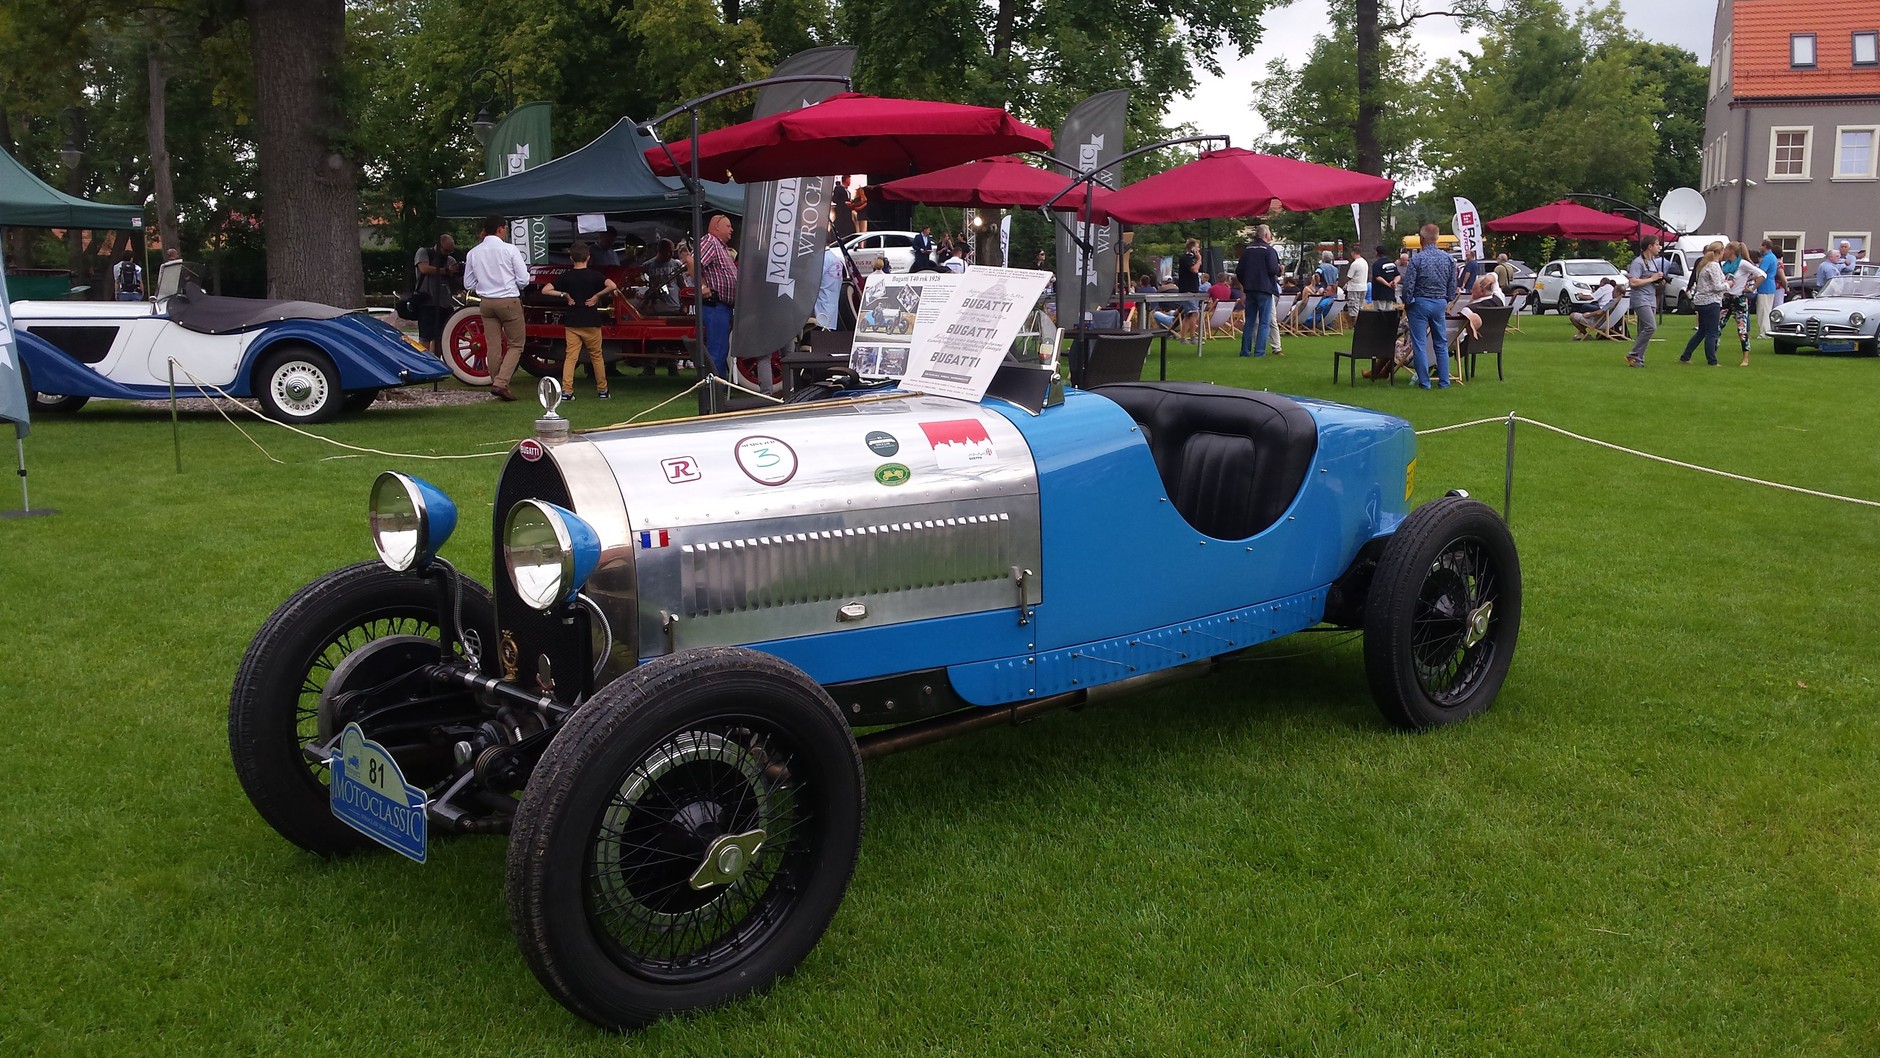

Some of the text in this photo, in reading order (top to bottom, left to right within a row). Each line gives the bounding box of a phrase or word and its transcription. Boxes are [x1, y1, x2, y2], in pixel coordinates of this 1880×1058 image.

[797, 176, 824, 258] WROCŁ
[769, 178, 797, 279] MOTOCL
[891, 275, 910, 283] Bugatti
[961, 298, 1013, 313] BUGATTI
[946, 324, 998, 339] BUGATTI
[930, 351, 981, 368] BUGATTI
[753, 447, 780, 468] 3
[369, 758, 384, 789] 81
[334, 772, 421, 843] MOTOCLASSIC
